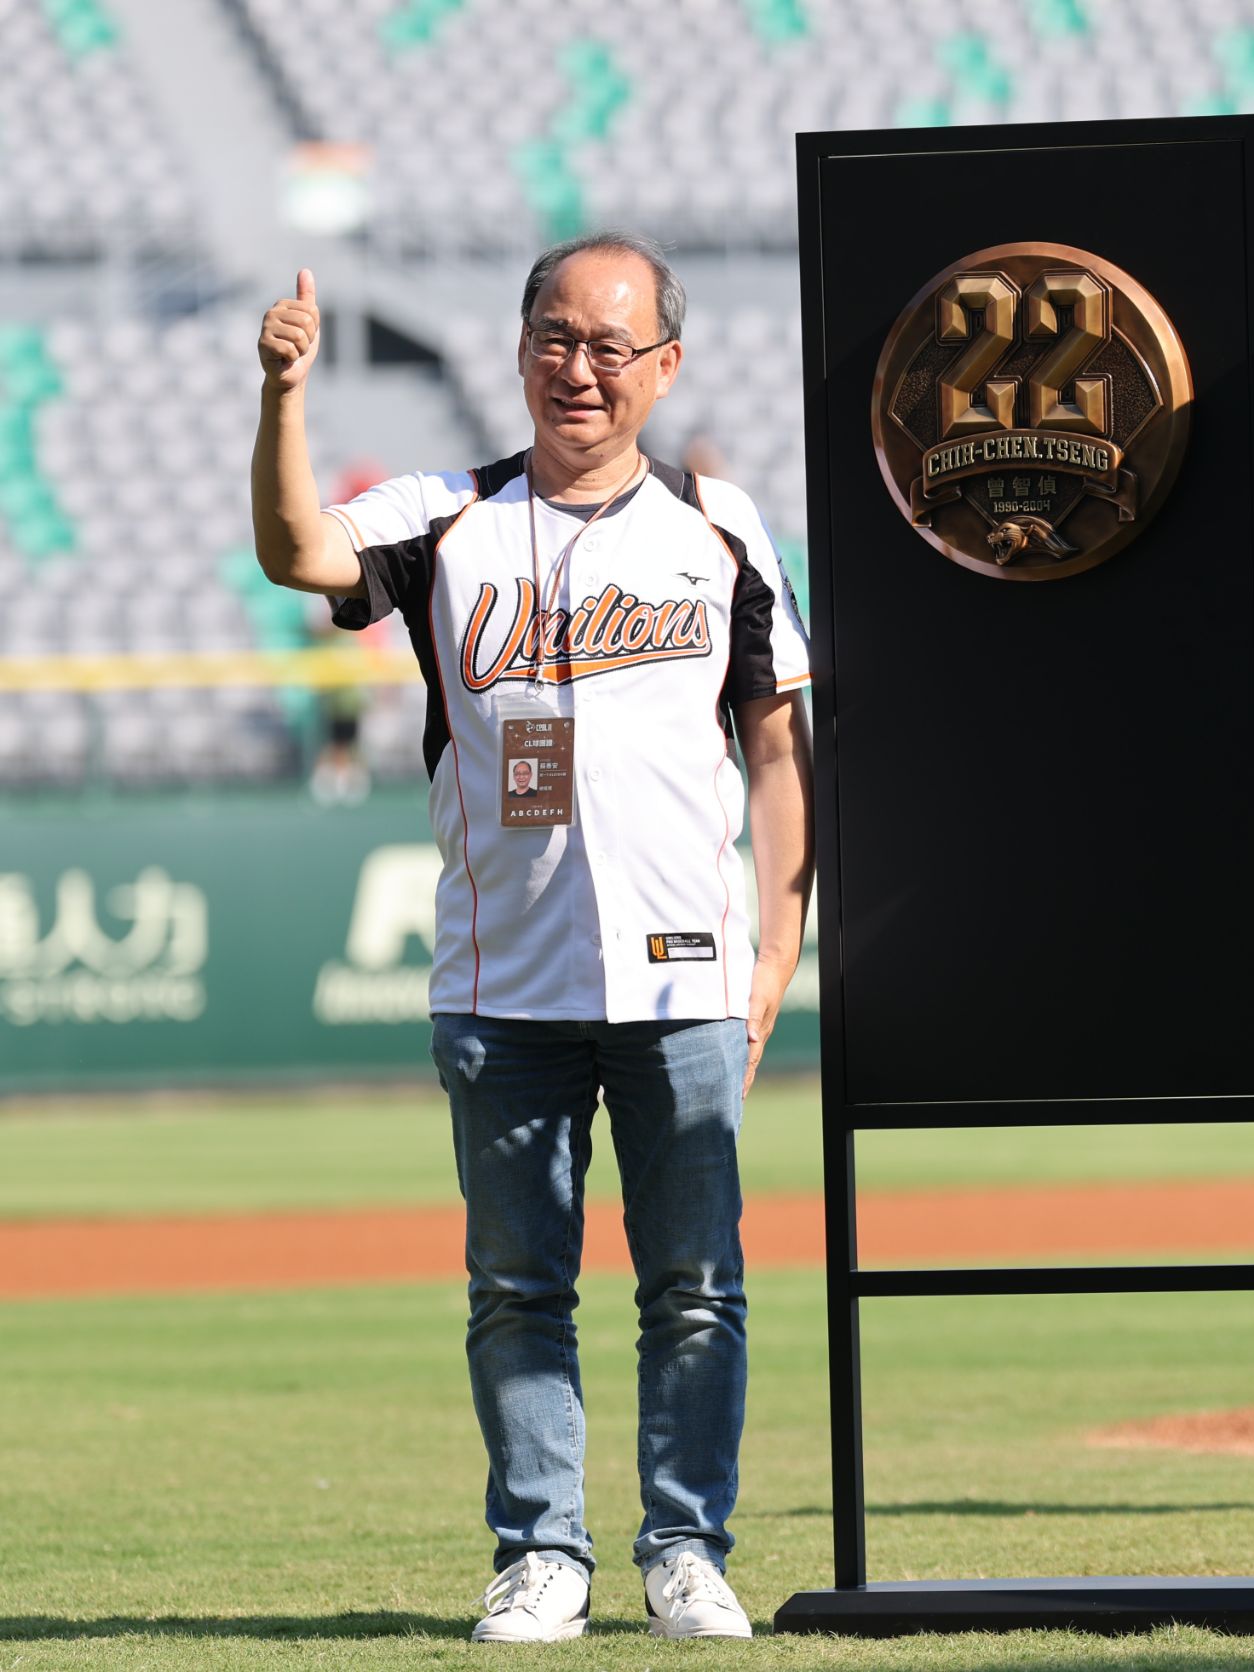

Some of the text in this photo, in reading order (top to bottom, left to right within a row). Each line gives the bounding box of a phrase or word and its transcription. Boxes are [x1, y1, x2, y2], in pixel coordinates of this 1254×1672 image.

[938, 273, 1110, 439] 22
[993, 499, 1051, 513] 1990-2004
[461, 577, 713, 694] Unilions
